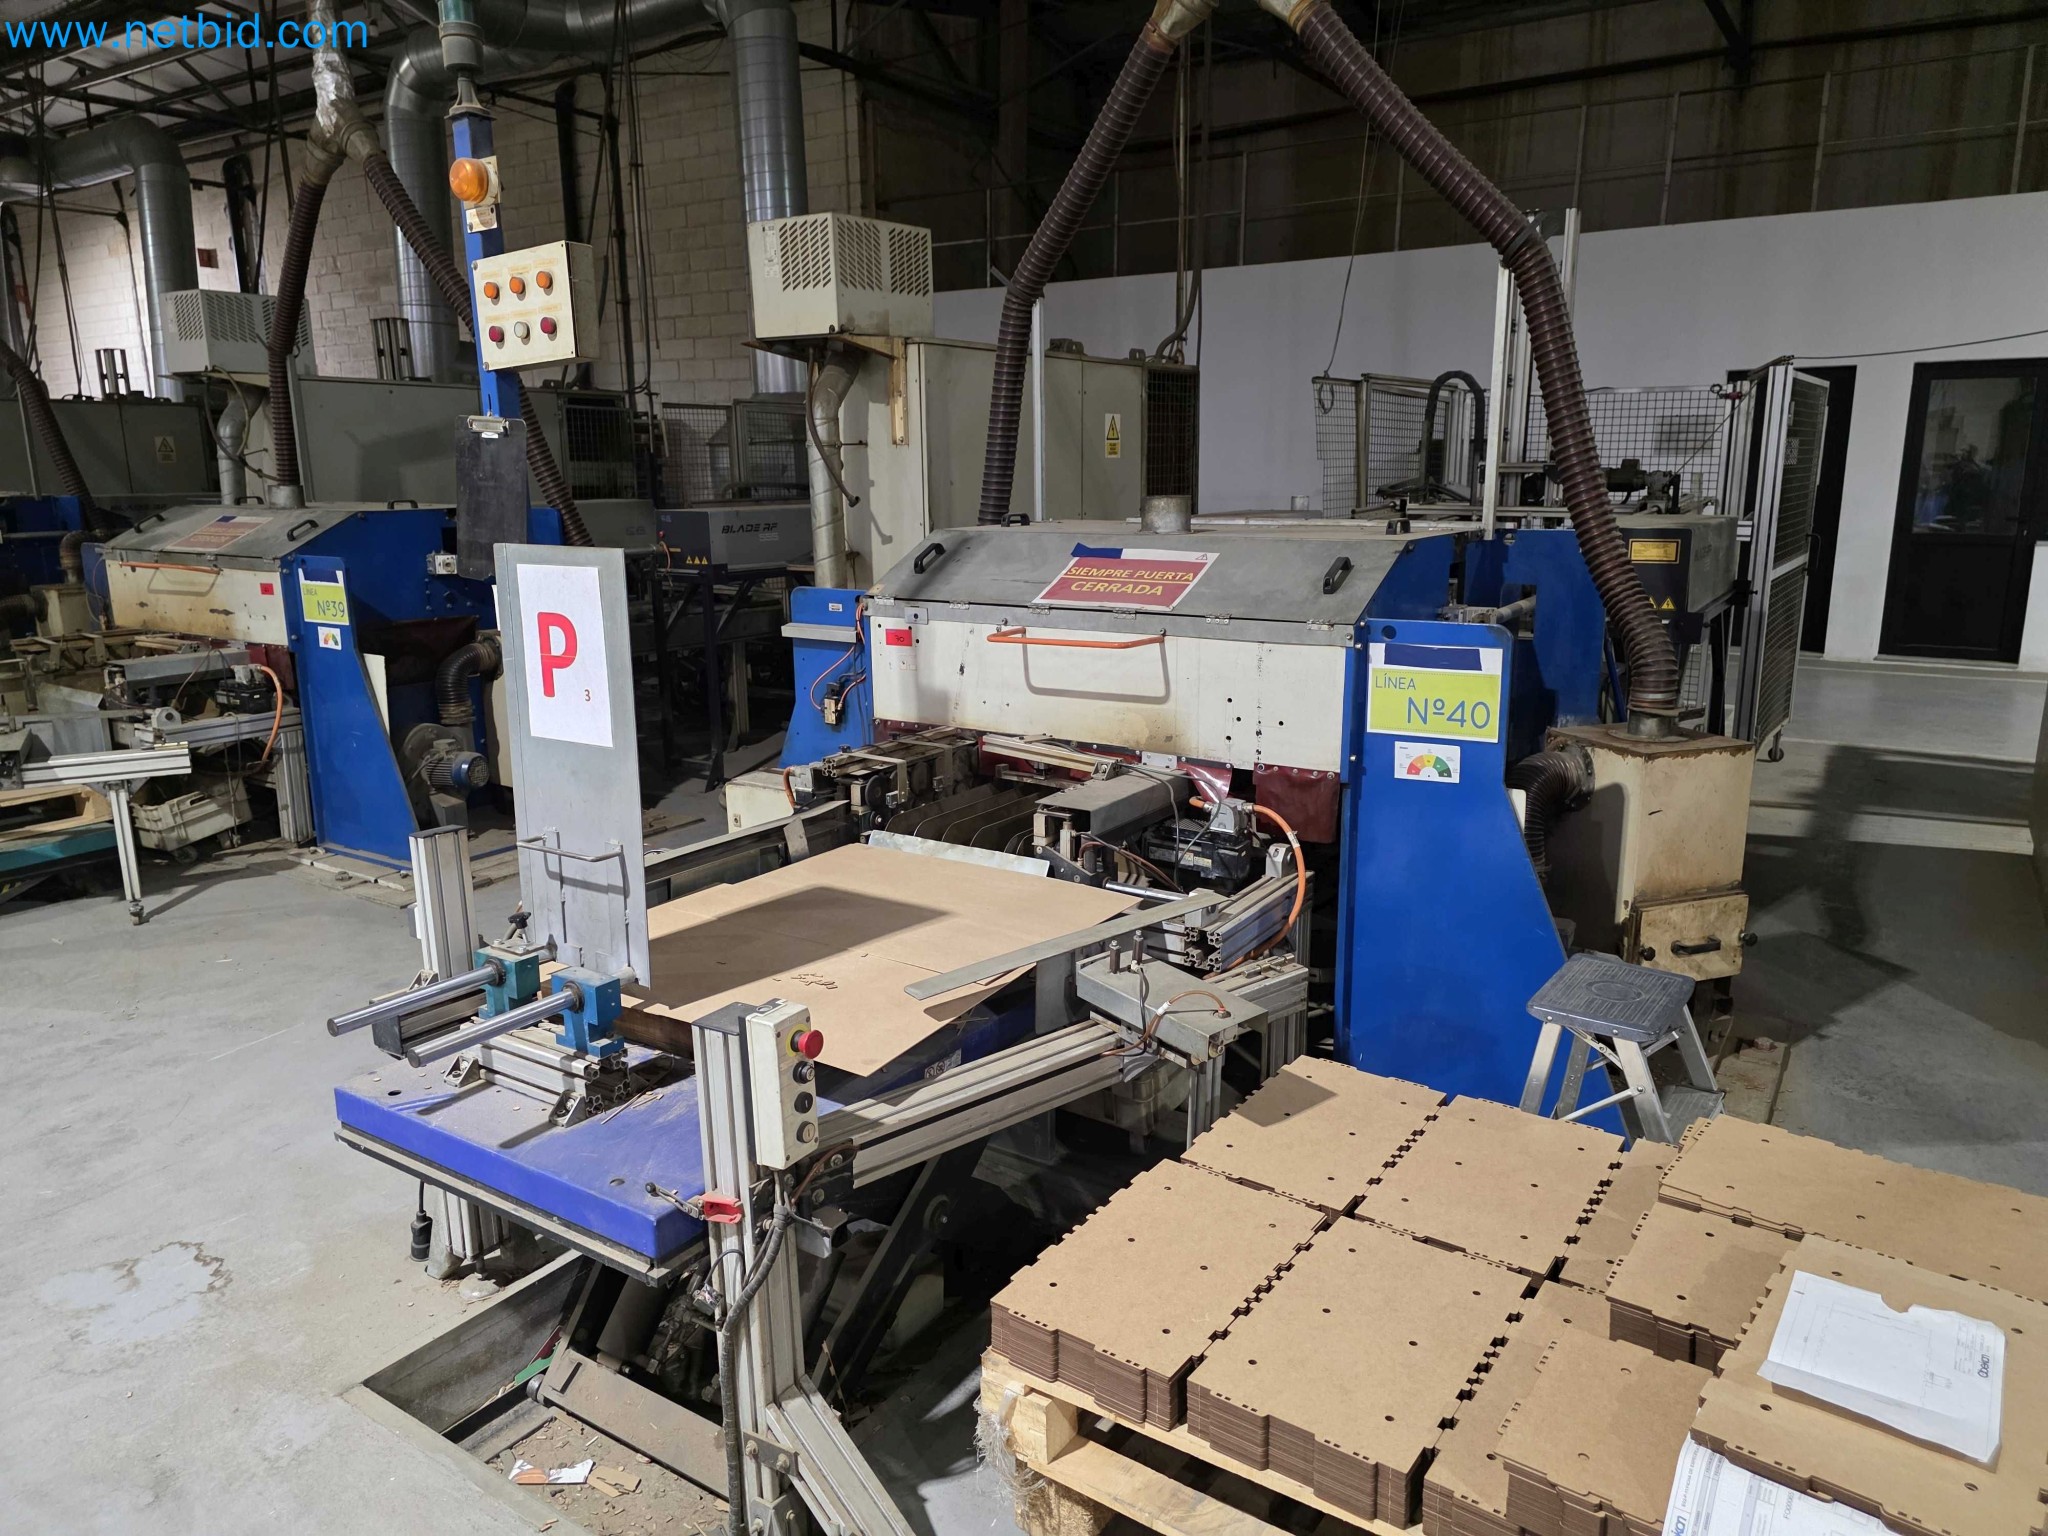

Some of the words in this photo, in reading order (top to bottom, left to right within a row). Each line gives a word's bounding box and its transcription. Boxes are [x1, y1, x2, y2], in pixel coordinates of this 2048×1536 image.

[721, 523, 761, 534] BLADE
[762, 522, 778, 532] RF
[1067, 566, 1134, 579] SIEMPRE
[1133, 570, 1194, 581] PUERTA
[1070, 581, 1163, 596] CERRADA
[537, 612, 577, 697] P
[1375, 673, 1416, 690] LÍNEA
[584, 689, 591, 702] 3
[1407, 696, 1491, 730] Nº40
